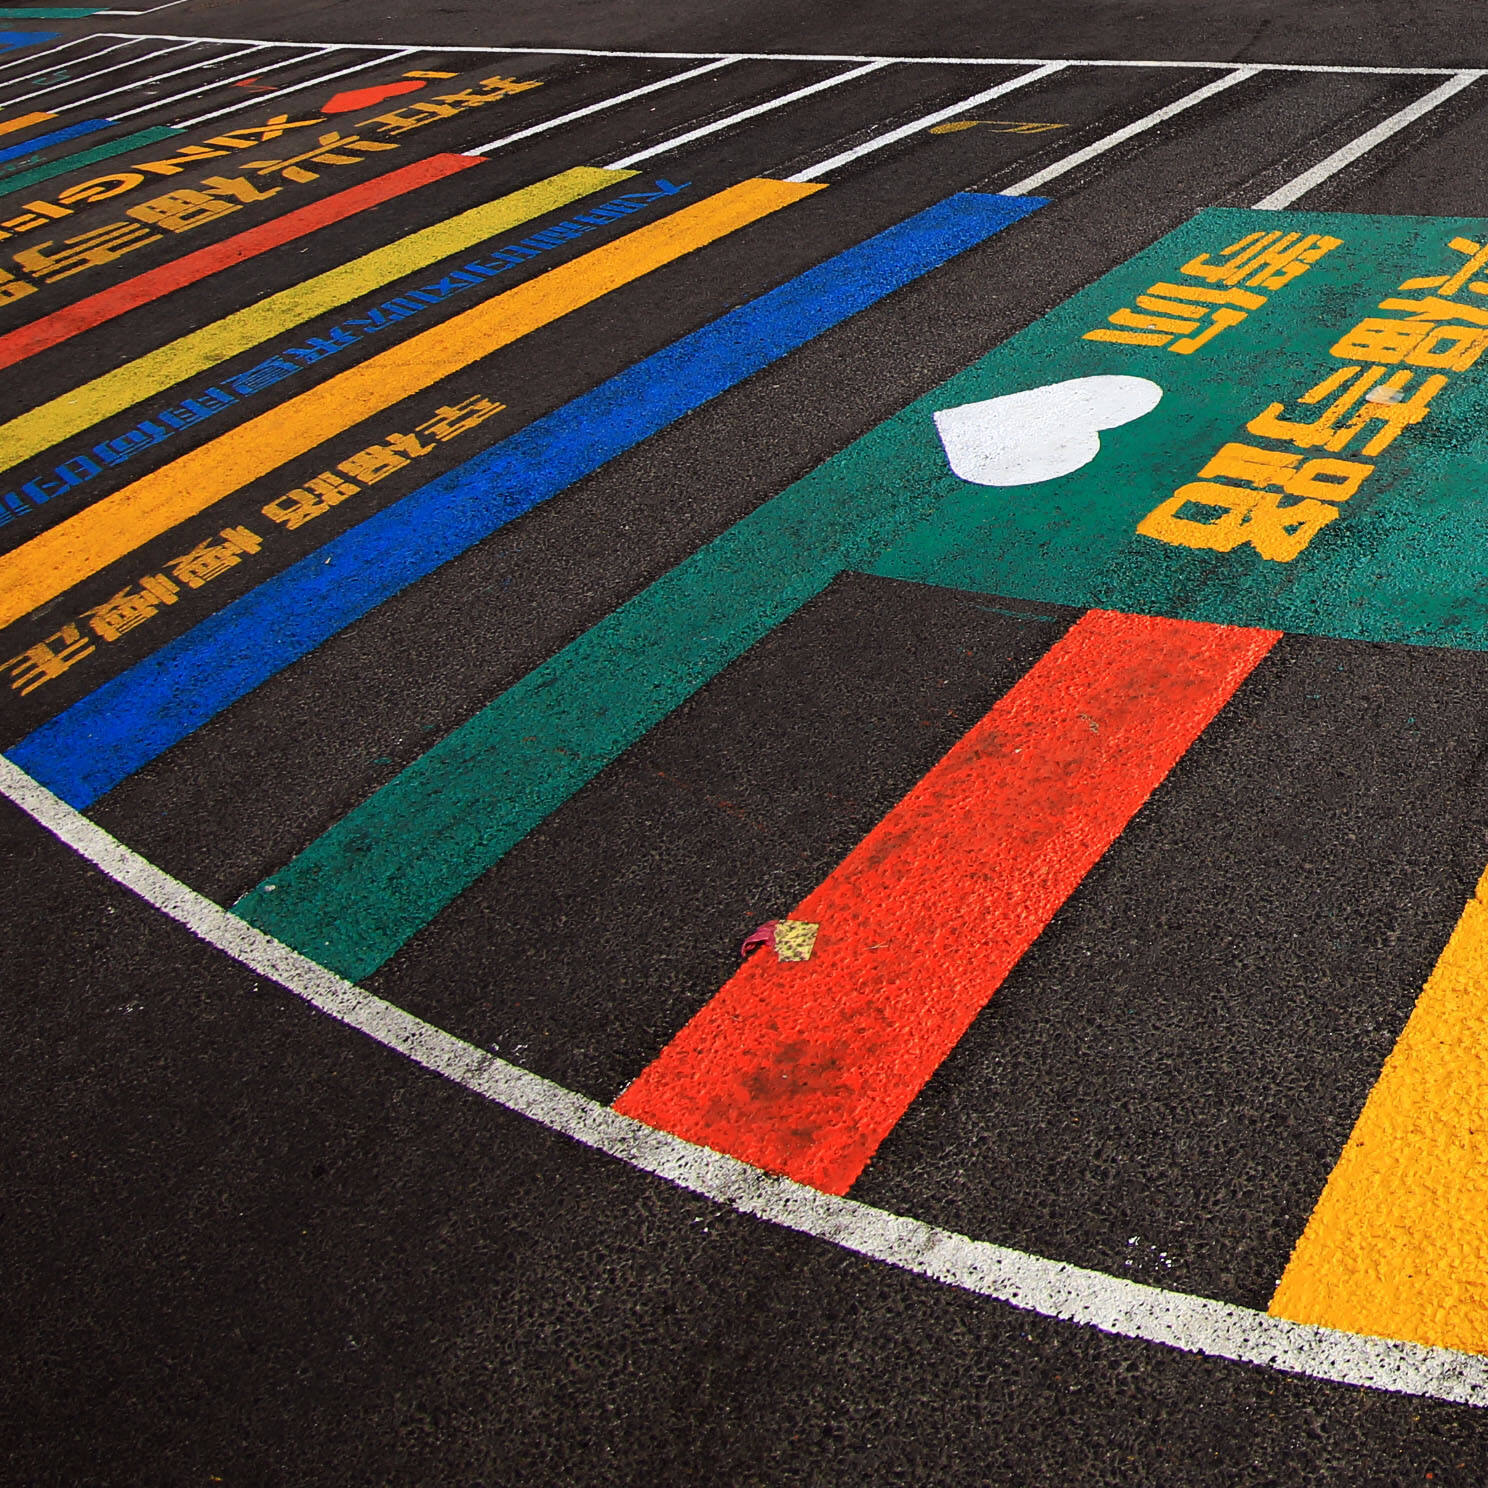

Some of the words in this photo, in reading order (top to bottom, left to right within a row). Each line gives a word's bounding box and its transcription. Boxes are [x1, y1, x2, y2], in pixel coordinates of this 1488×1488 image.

[0, 111, 328, 243] XINGF
[1080, 228, 1346, 355] 等你
[260, 393, 508, 533] 幸福路
[0, 525, 268, 699] 慢慢走
